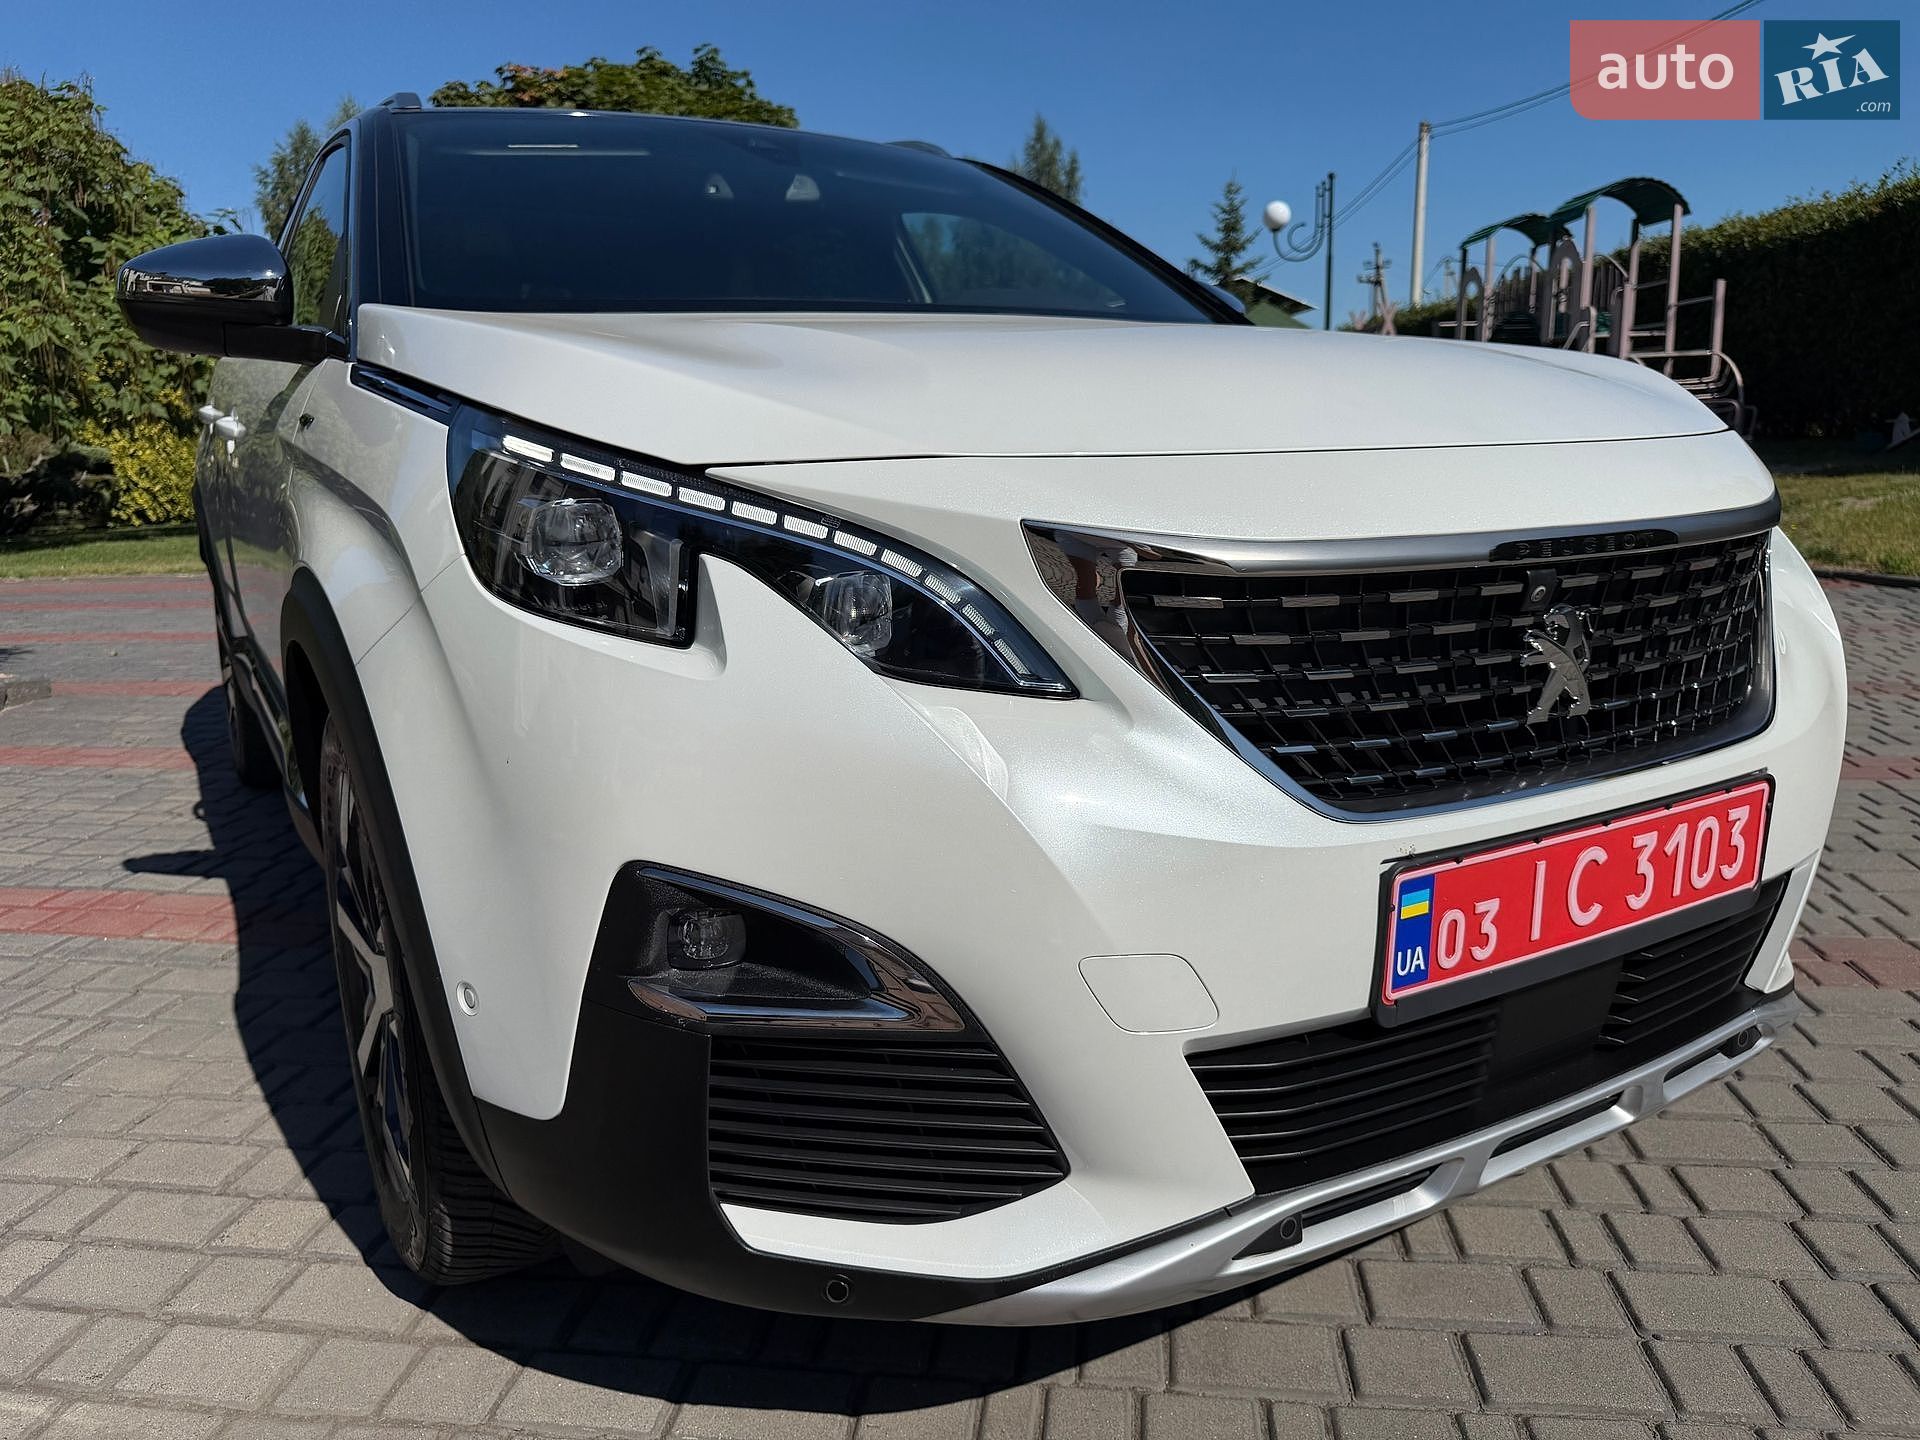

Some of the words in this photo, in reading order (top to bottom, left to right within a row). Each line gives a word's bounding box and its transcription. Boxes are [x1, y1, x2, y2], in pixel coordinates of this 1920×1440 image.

[1514, 532, 1655, 560] PEUGEOT
[1437, 897, 1501, 970] 03
[1530, 845, 1608, 942] IC
[1625, 804, 1750, 911] 3103
[1396, 946, 1426, 977] UA
